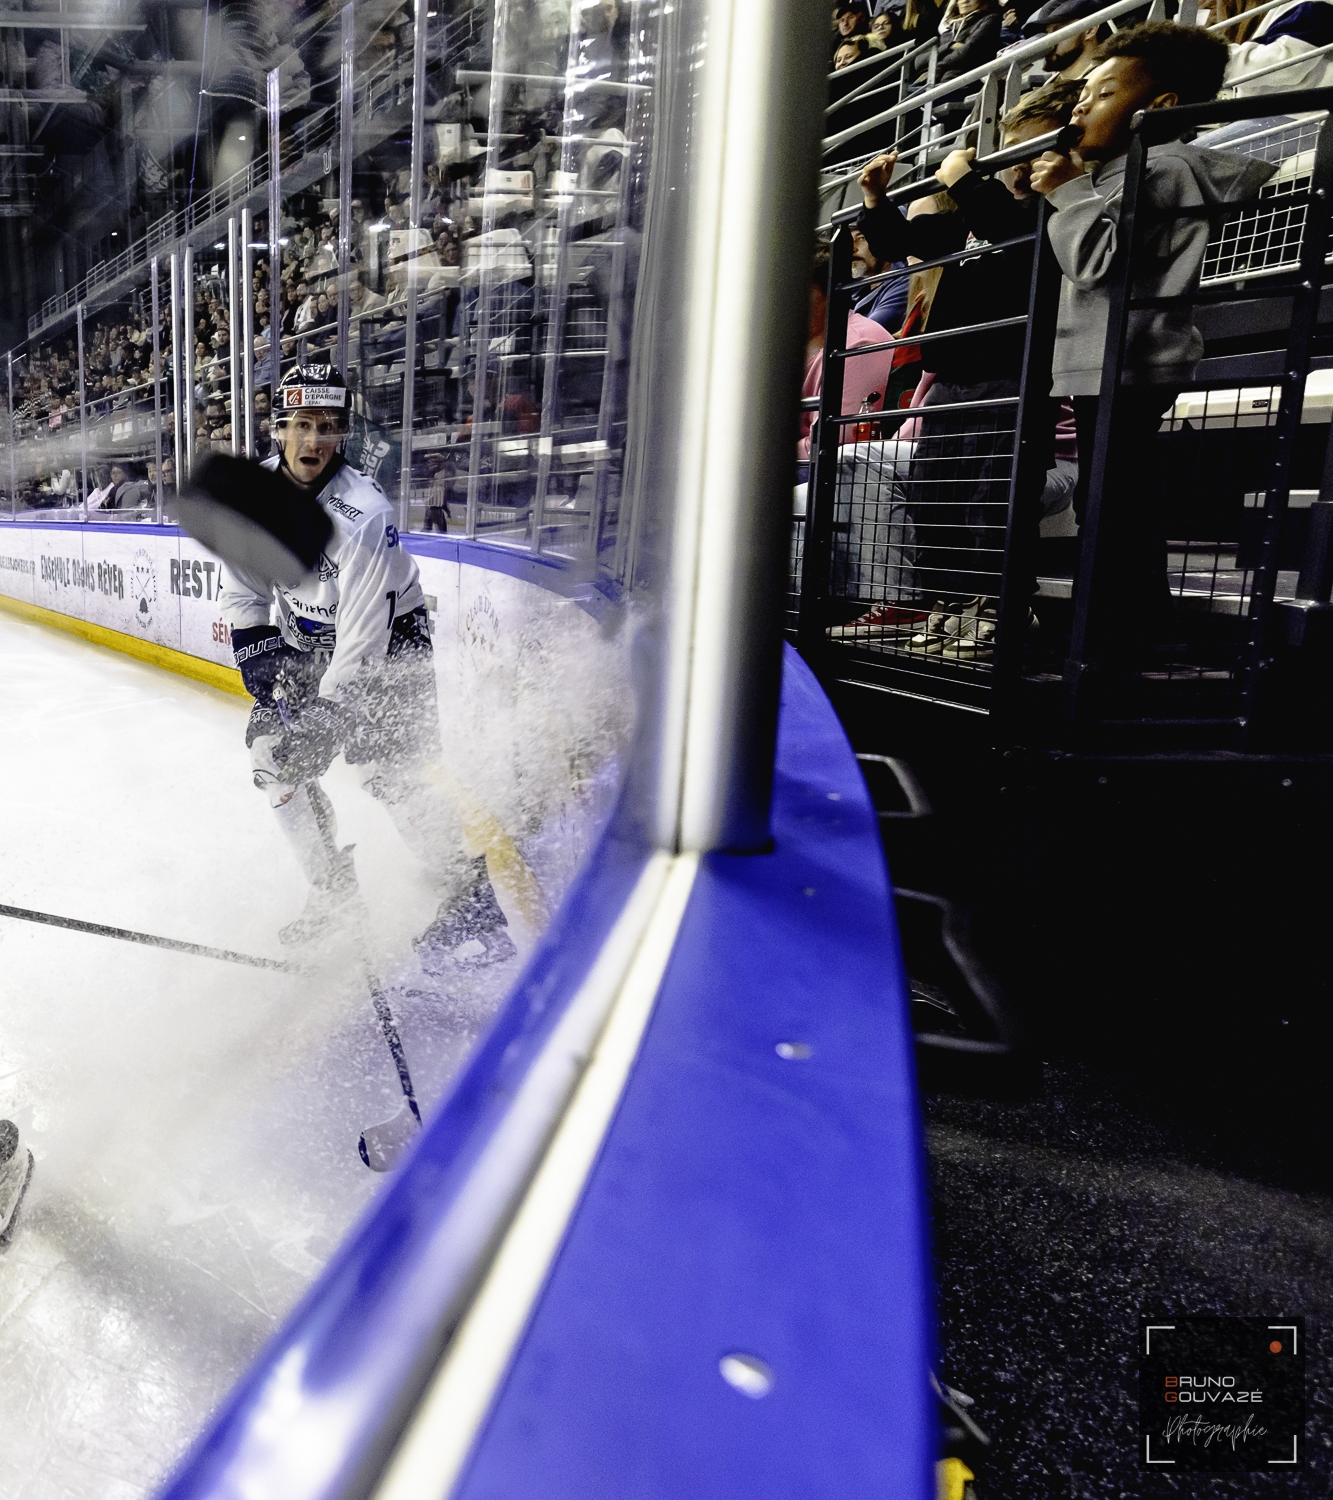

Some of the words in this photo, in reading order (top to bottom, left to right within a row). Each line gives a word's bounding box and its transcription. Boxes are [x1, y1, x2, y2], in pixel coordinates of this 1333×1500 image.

[304, 393, 342, 401] D'EPARGNE
[40, 554, 71, 592] ENSEMBLE
[72, 558, 96, 593] OSONS
[97, 559, 124, 601] RÊVER
[169, 558, 221, 602] REST
